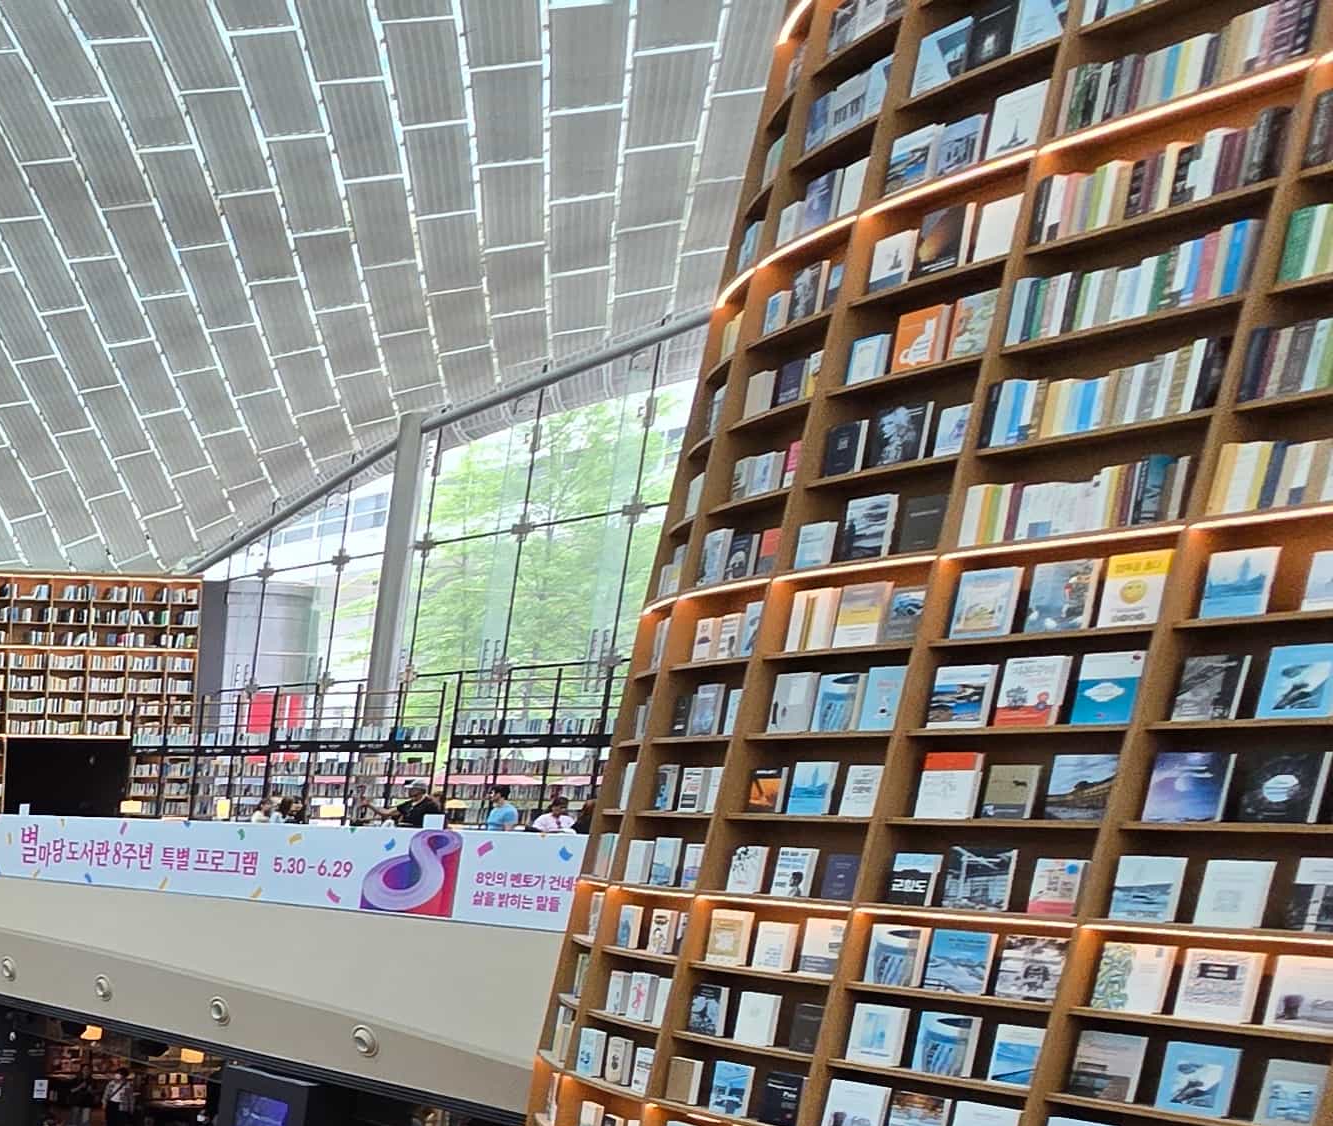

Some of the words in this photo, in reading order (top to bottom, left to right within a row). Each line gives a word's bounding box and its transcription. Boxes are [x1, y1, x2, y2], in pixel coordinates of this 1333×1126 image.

[160, 846, 190, 871] 특별
[193, 850, 258, 876] 프로그램
[476, 871, 507, 887] 8인의
[510, 873, 546, 890] 멘토가
[498, 893, 534, 910] 밝히는
